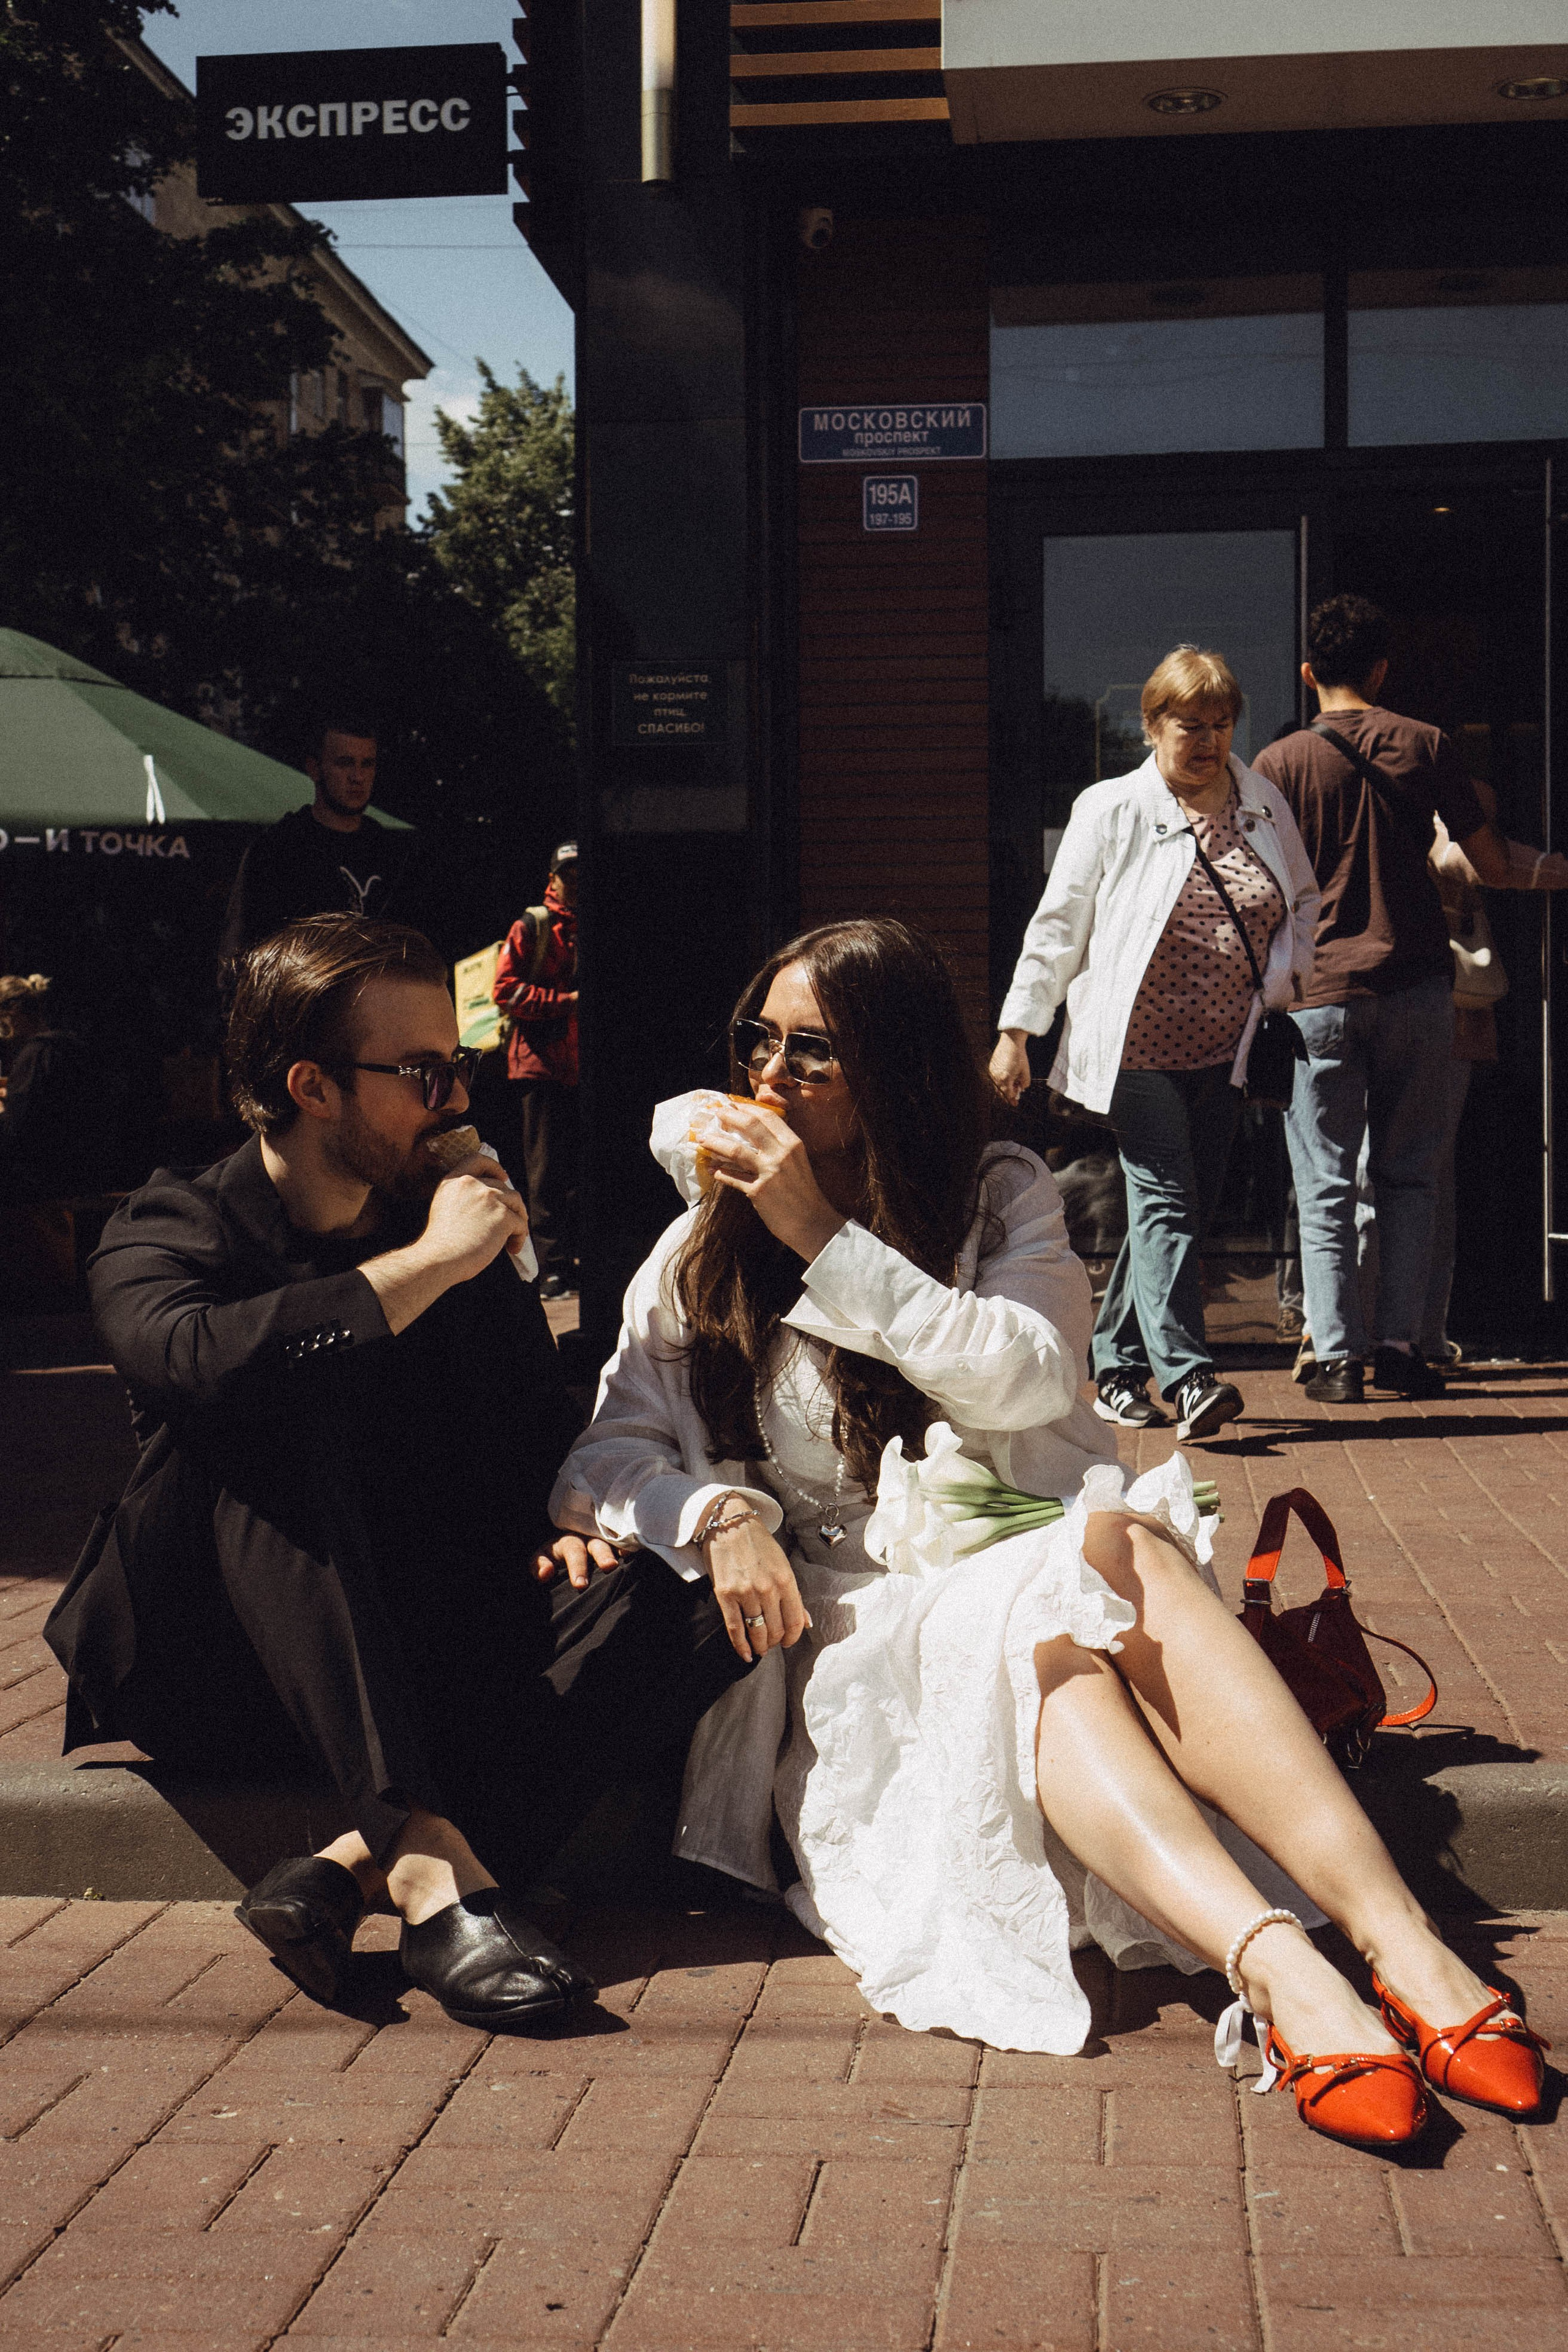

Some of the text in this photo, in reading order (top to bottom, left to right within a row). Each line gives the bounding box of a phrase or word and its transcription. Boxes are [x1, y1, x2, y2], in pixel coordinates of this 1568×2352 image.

[224, 97, 471, 141] ЭКСПРЕСС
[813, 407, 971, 430] МОСКОВСКИЙ
[854, 430, 929, 447] проспект
[869, 483, 912, 505] 195А
[870, 513, 912, 526] 197-195
[633, 692, 708, 703] не кормите
[638, 722, 705, 734] СПАСИБО!
[80, 831, 190, 859] ТОЧКА
